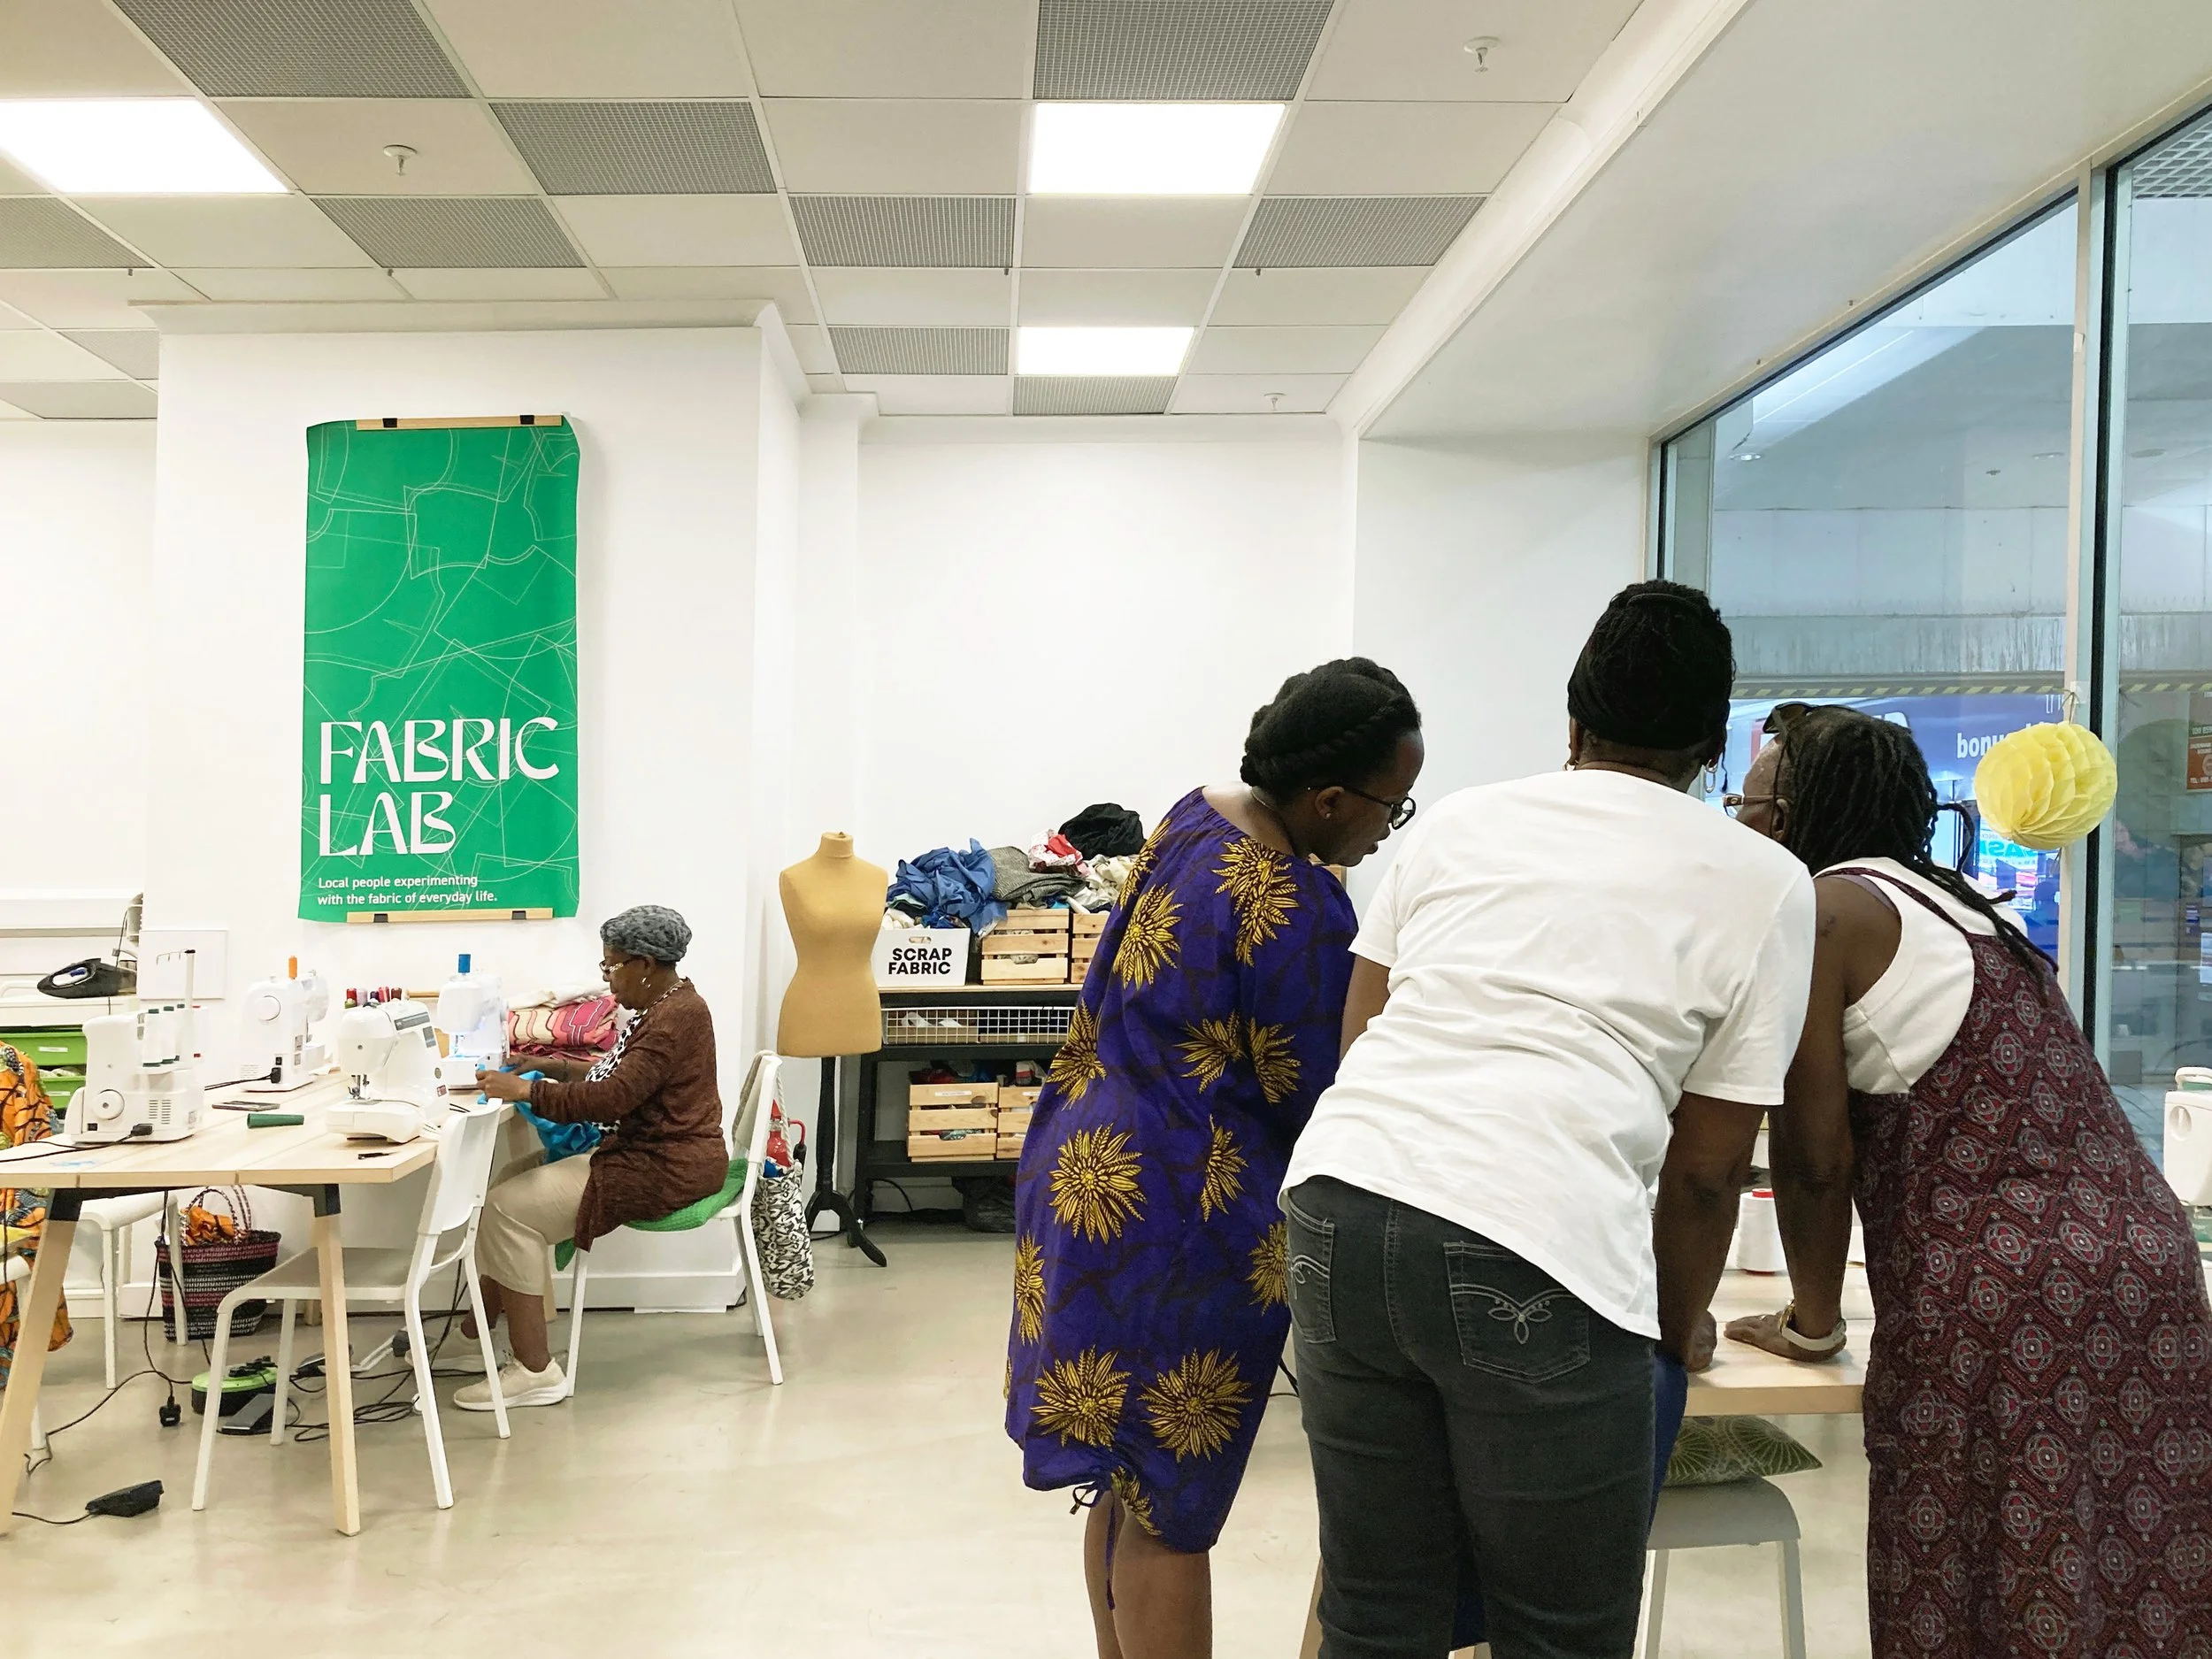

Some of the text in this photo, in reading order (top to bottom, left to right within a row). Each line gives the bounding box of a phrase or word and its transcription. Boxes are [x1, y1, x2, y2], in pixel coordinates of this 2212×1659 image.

[320, 717, 559, 784] FABRIC
[319, 792, 456, 856] LAB
[319, 874, 478, 890] Local people experimenting
[317, 890, 498, 905] with the fabric of everyday life.
[892, 948, 952, 961] SCRAP
[888, 962, 951, 975] FABRIC
